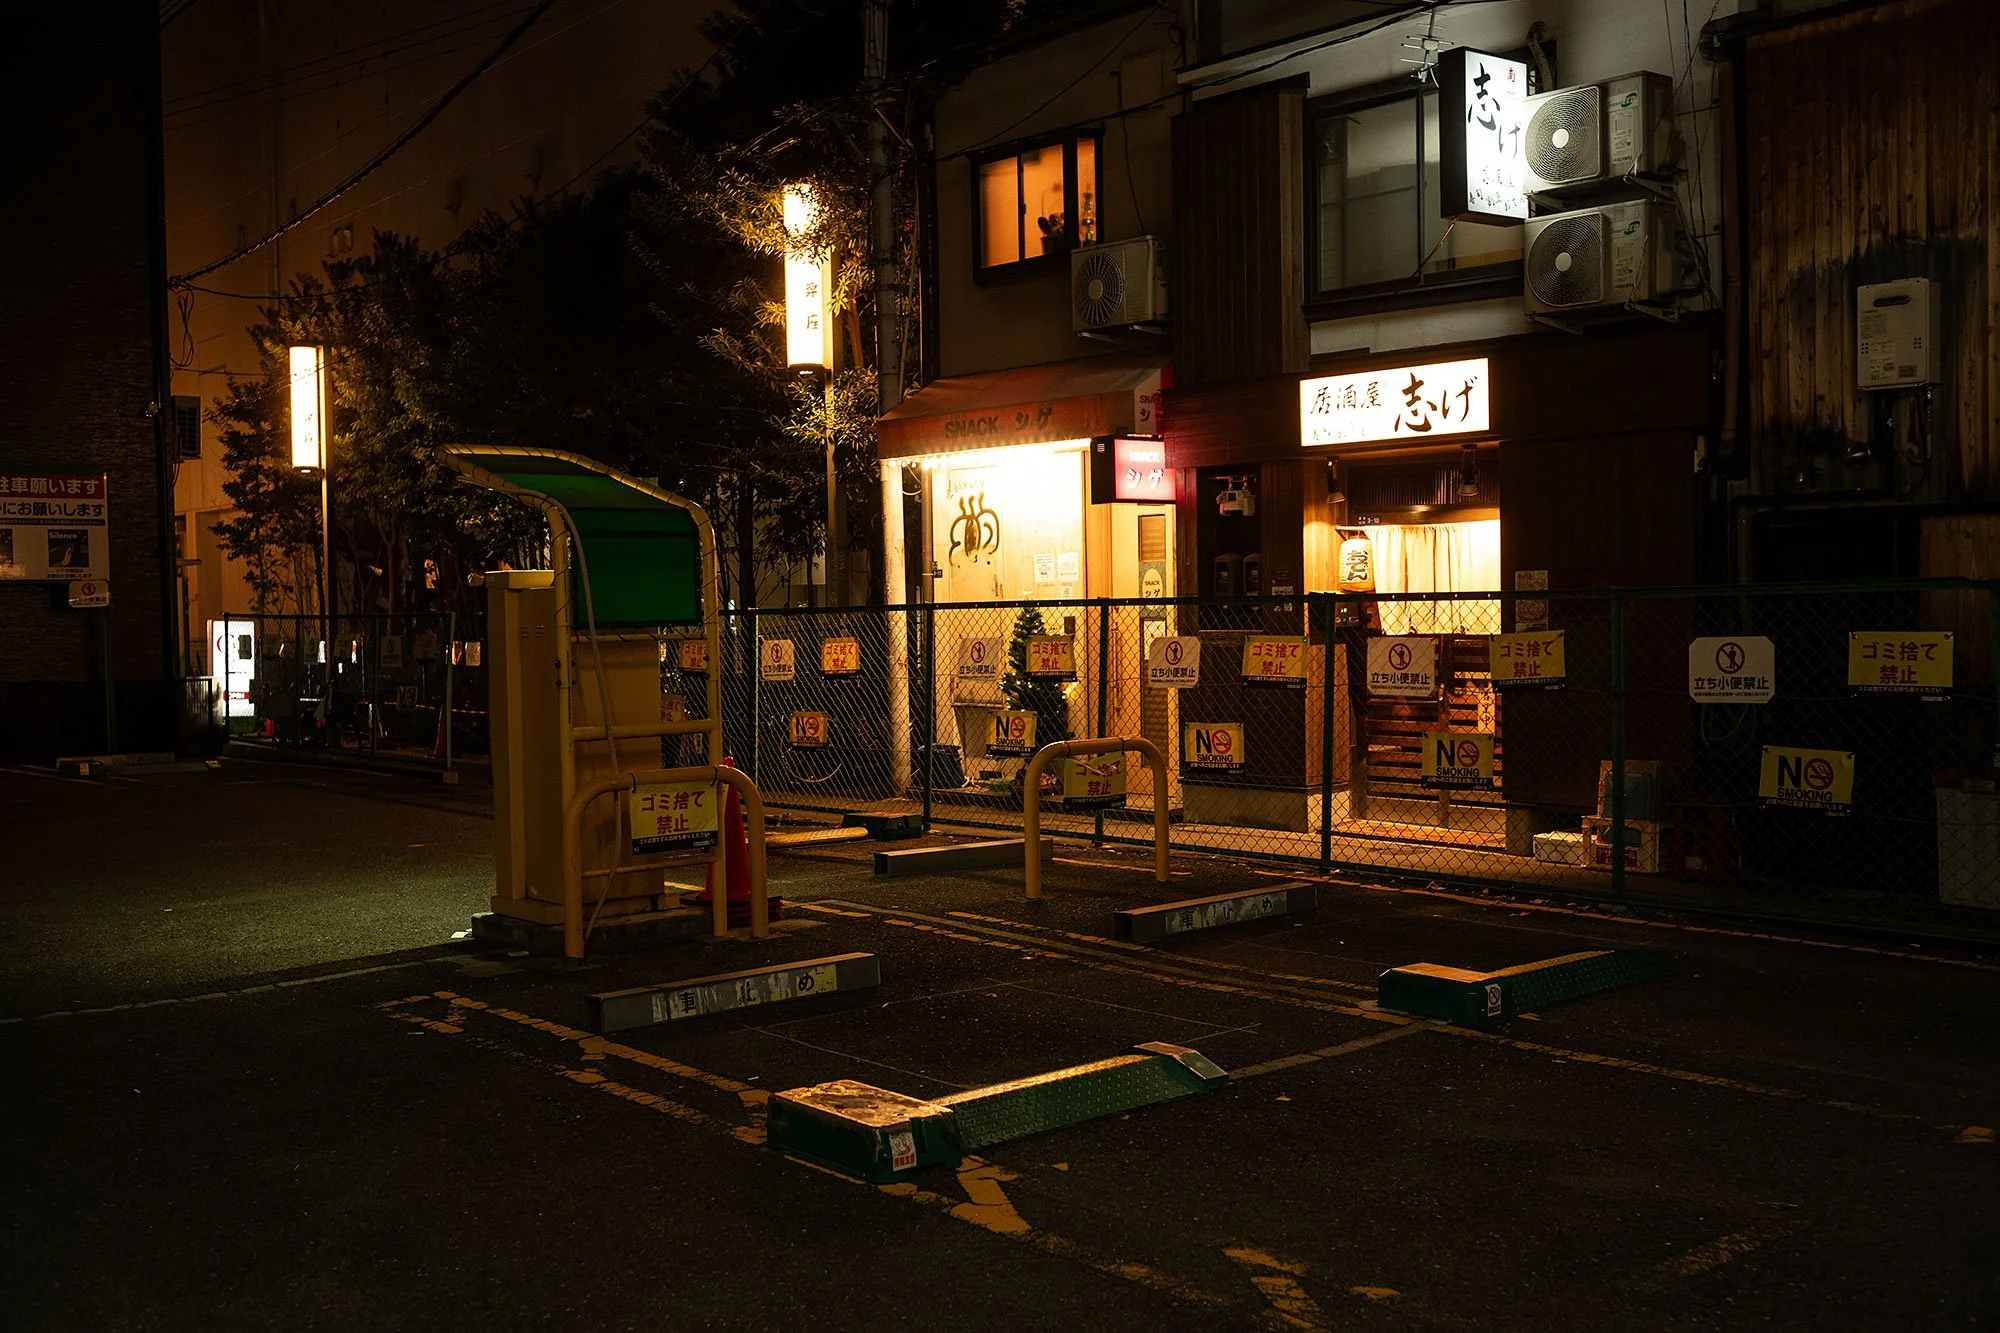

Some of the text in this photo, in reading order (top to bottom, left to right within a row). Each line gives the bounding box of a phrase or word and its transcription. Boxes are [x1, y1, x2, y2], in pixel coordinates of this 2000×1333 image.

[1310, 371, 1478, 434] 居酒屋 志げ
[944, 405, 1053, 441] SNACK シゲ
[1126, 469, 1164, 490] シゲ
[49, 531, 78, 541] Silence
[1145, 588, 1161, 598] シゲ
[826, 644, 855, 656] ゴミ捨て
[1032, 642, 1069, 656] ゴミ捨て
[1252, 642, 1301, 659] ゴミ捨て
[1500, 640, 1554, 658] ゴミ捨て
[1862, 640, 1939, 662] ゴミ捨て
[832, 658, 849, 669] 禁止
[959, 664, 997, 675] 立ち小便禁止
[1041, 657, 1061, 671] 禁止
[1262, 660, 1287, 676] 禁止
[1513, 660, 1542, 678] 禁止
[1151, 667, 1196, 678] 立ち小便禁止
[1371, 672, 1431, 685] 立ち小便禁止
[1880, 664, 1919, 684] 禁止
[1694, 676, 1770, 690] 立ち小便禁止
[995, 738, 1025, 747] SMOKING
[1197, 753, 1234, 763] SMOKING
[1436, 767, 1480, 777] SMOKING
[1087, 779, 1112, 796] 禁止
[1777, 787, 1834, 803] SMOKING
[641, 790, 706, 812] ゴミ捨て
[656, 813, 691, 835] 禁止
